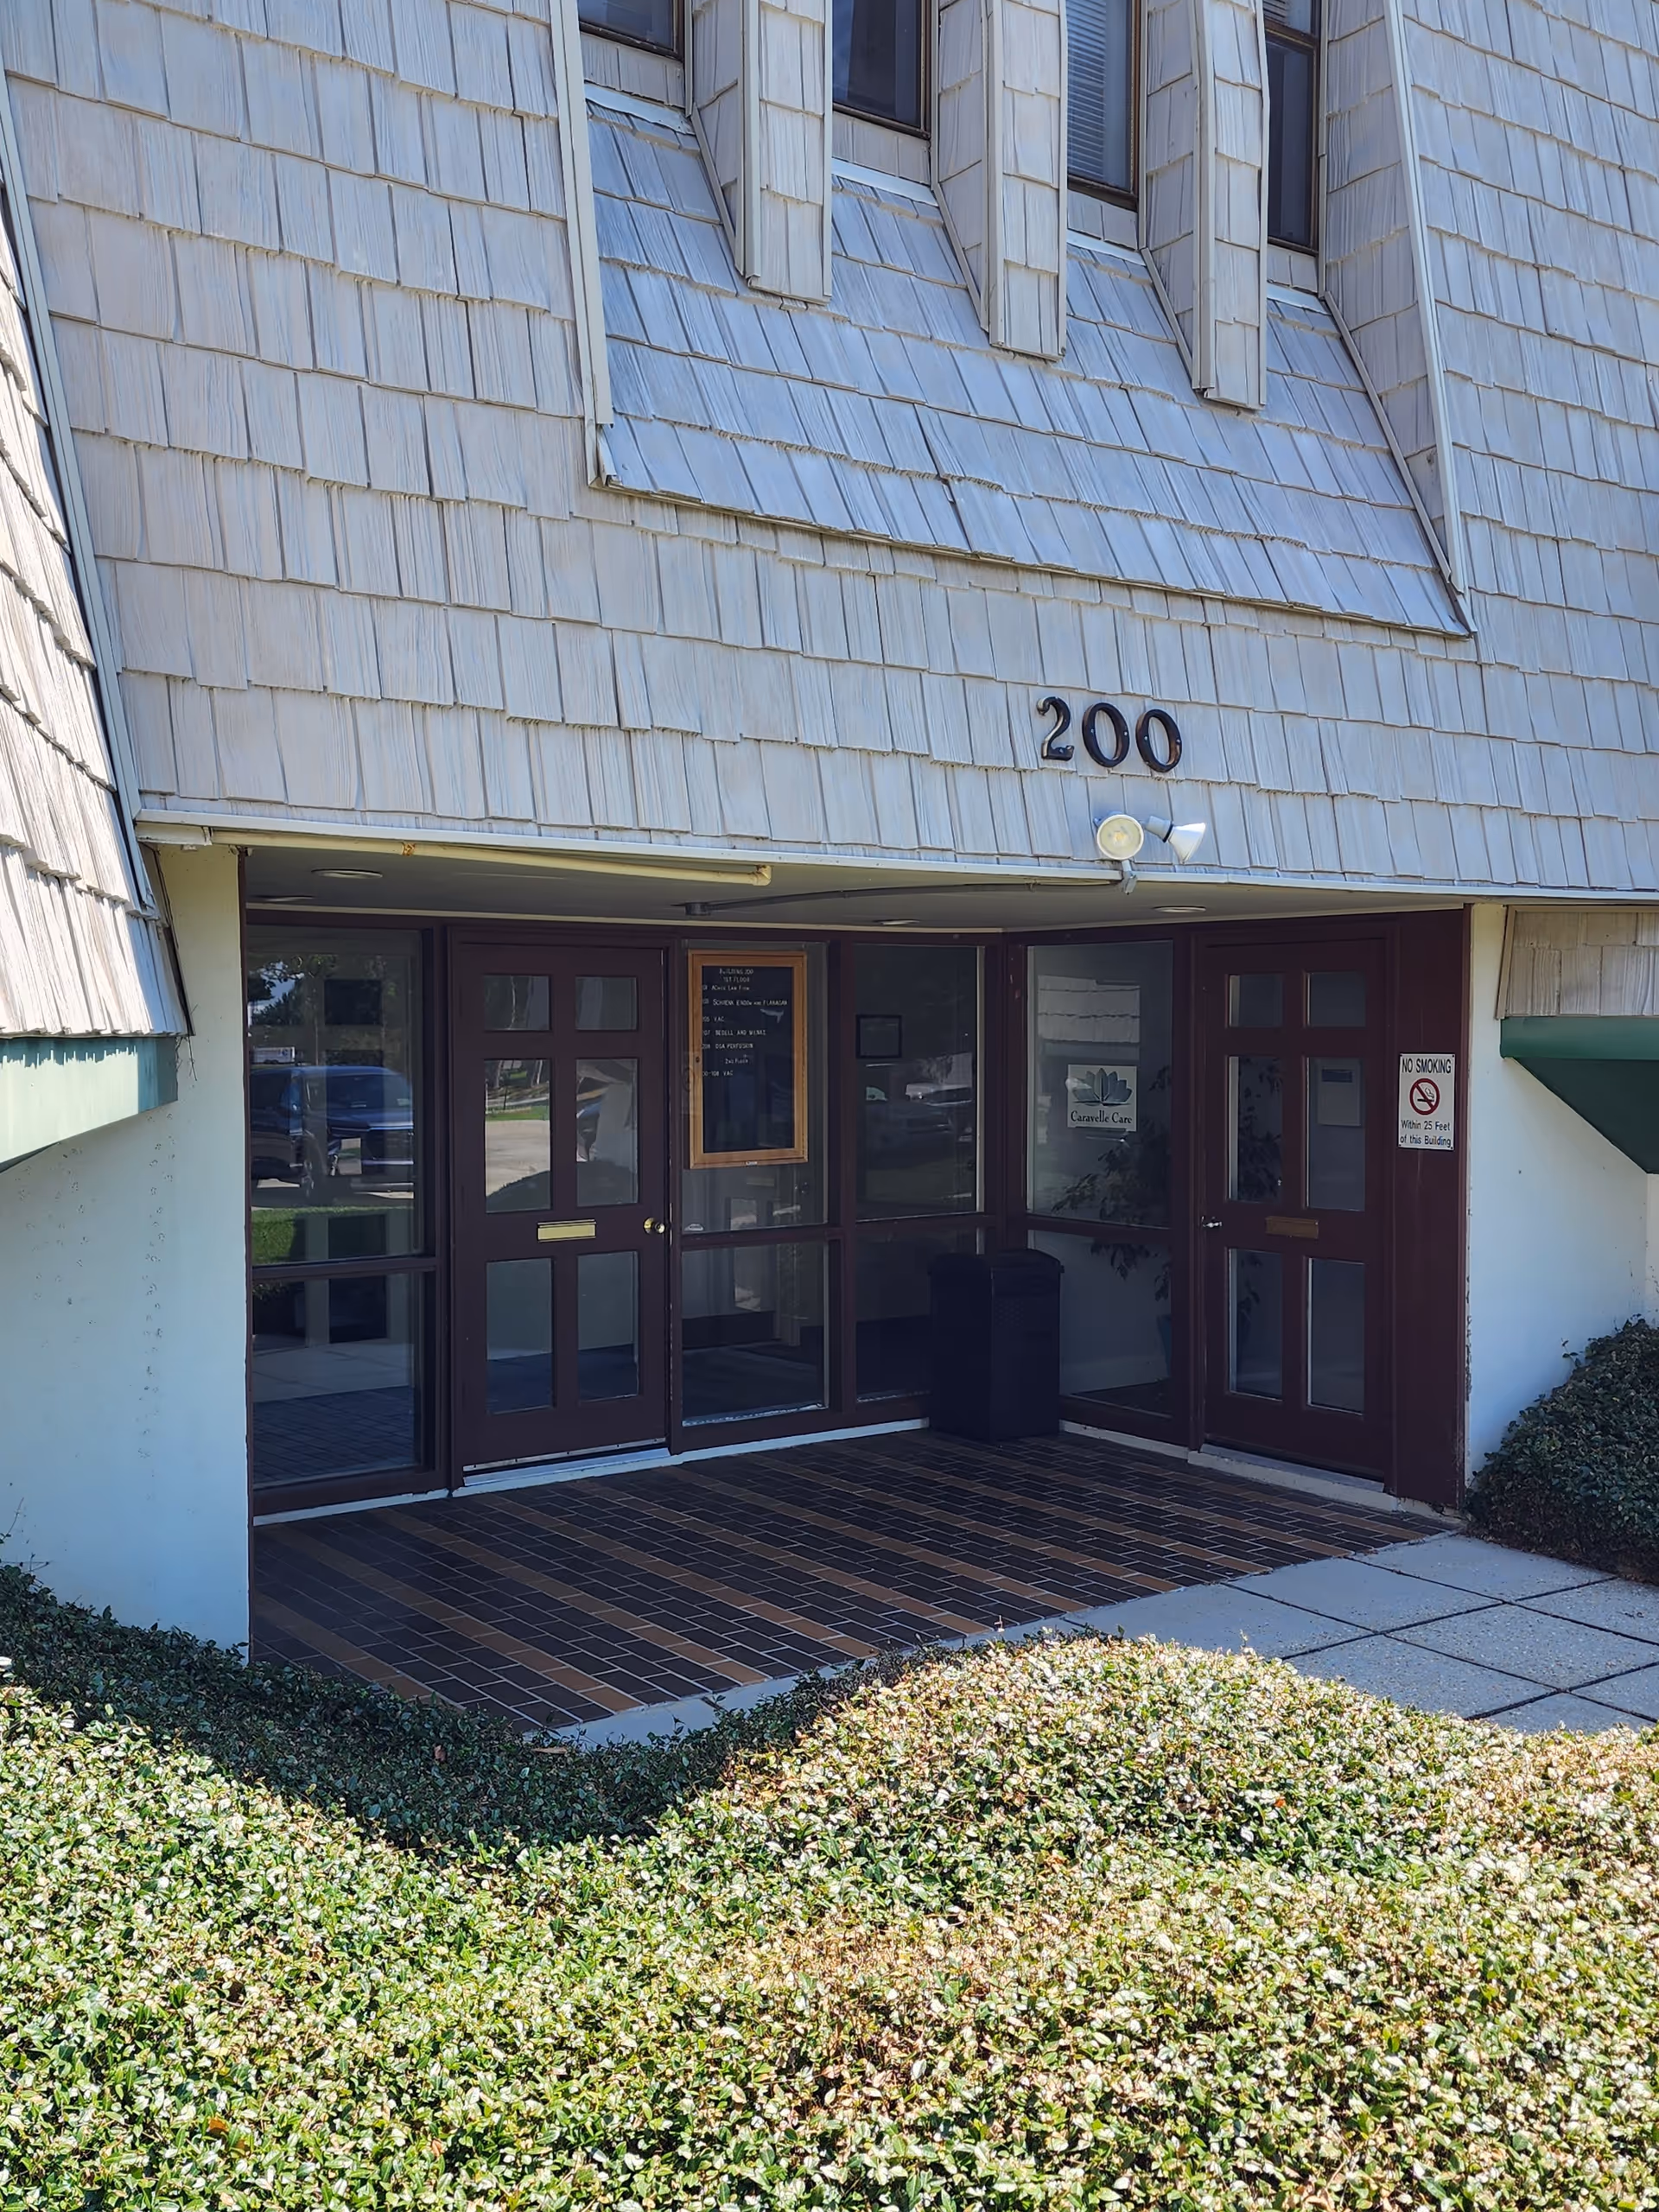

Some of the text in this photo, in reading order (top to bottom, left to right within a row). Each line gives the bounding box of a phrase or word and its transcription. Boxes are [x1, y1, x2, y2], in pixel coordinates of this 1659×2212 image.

[1036, 696, 1183, 773] 200
[1402, 1058, 1452, 1074] NO SMOKING
[1071, 1109, 1133, 1124] Caravelle Care
[1401, 1120, 1451, 1131] Within 25 Feet
[1400, 1135, 1452, 1148] of this Building
